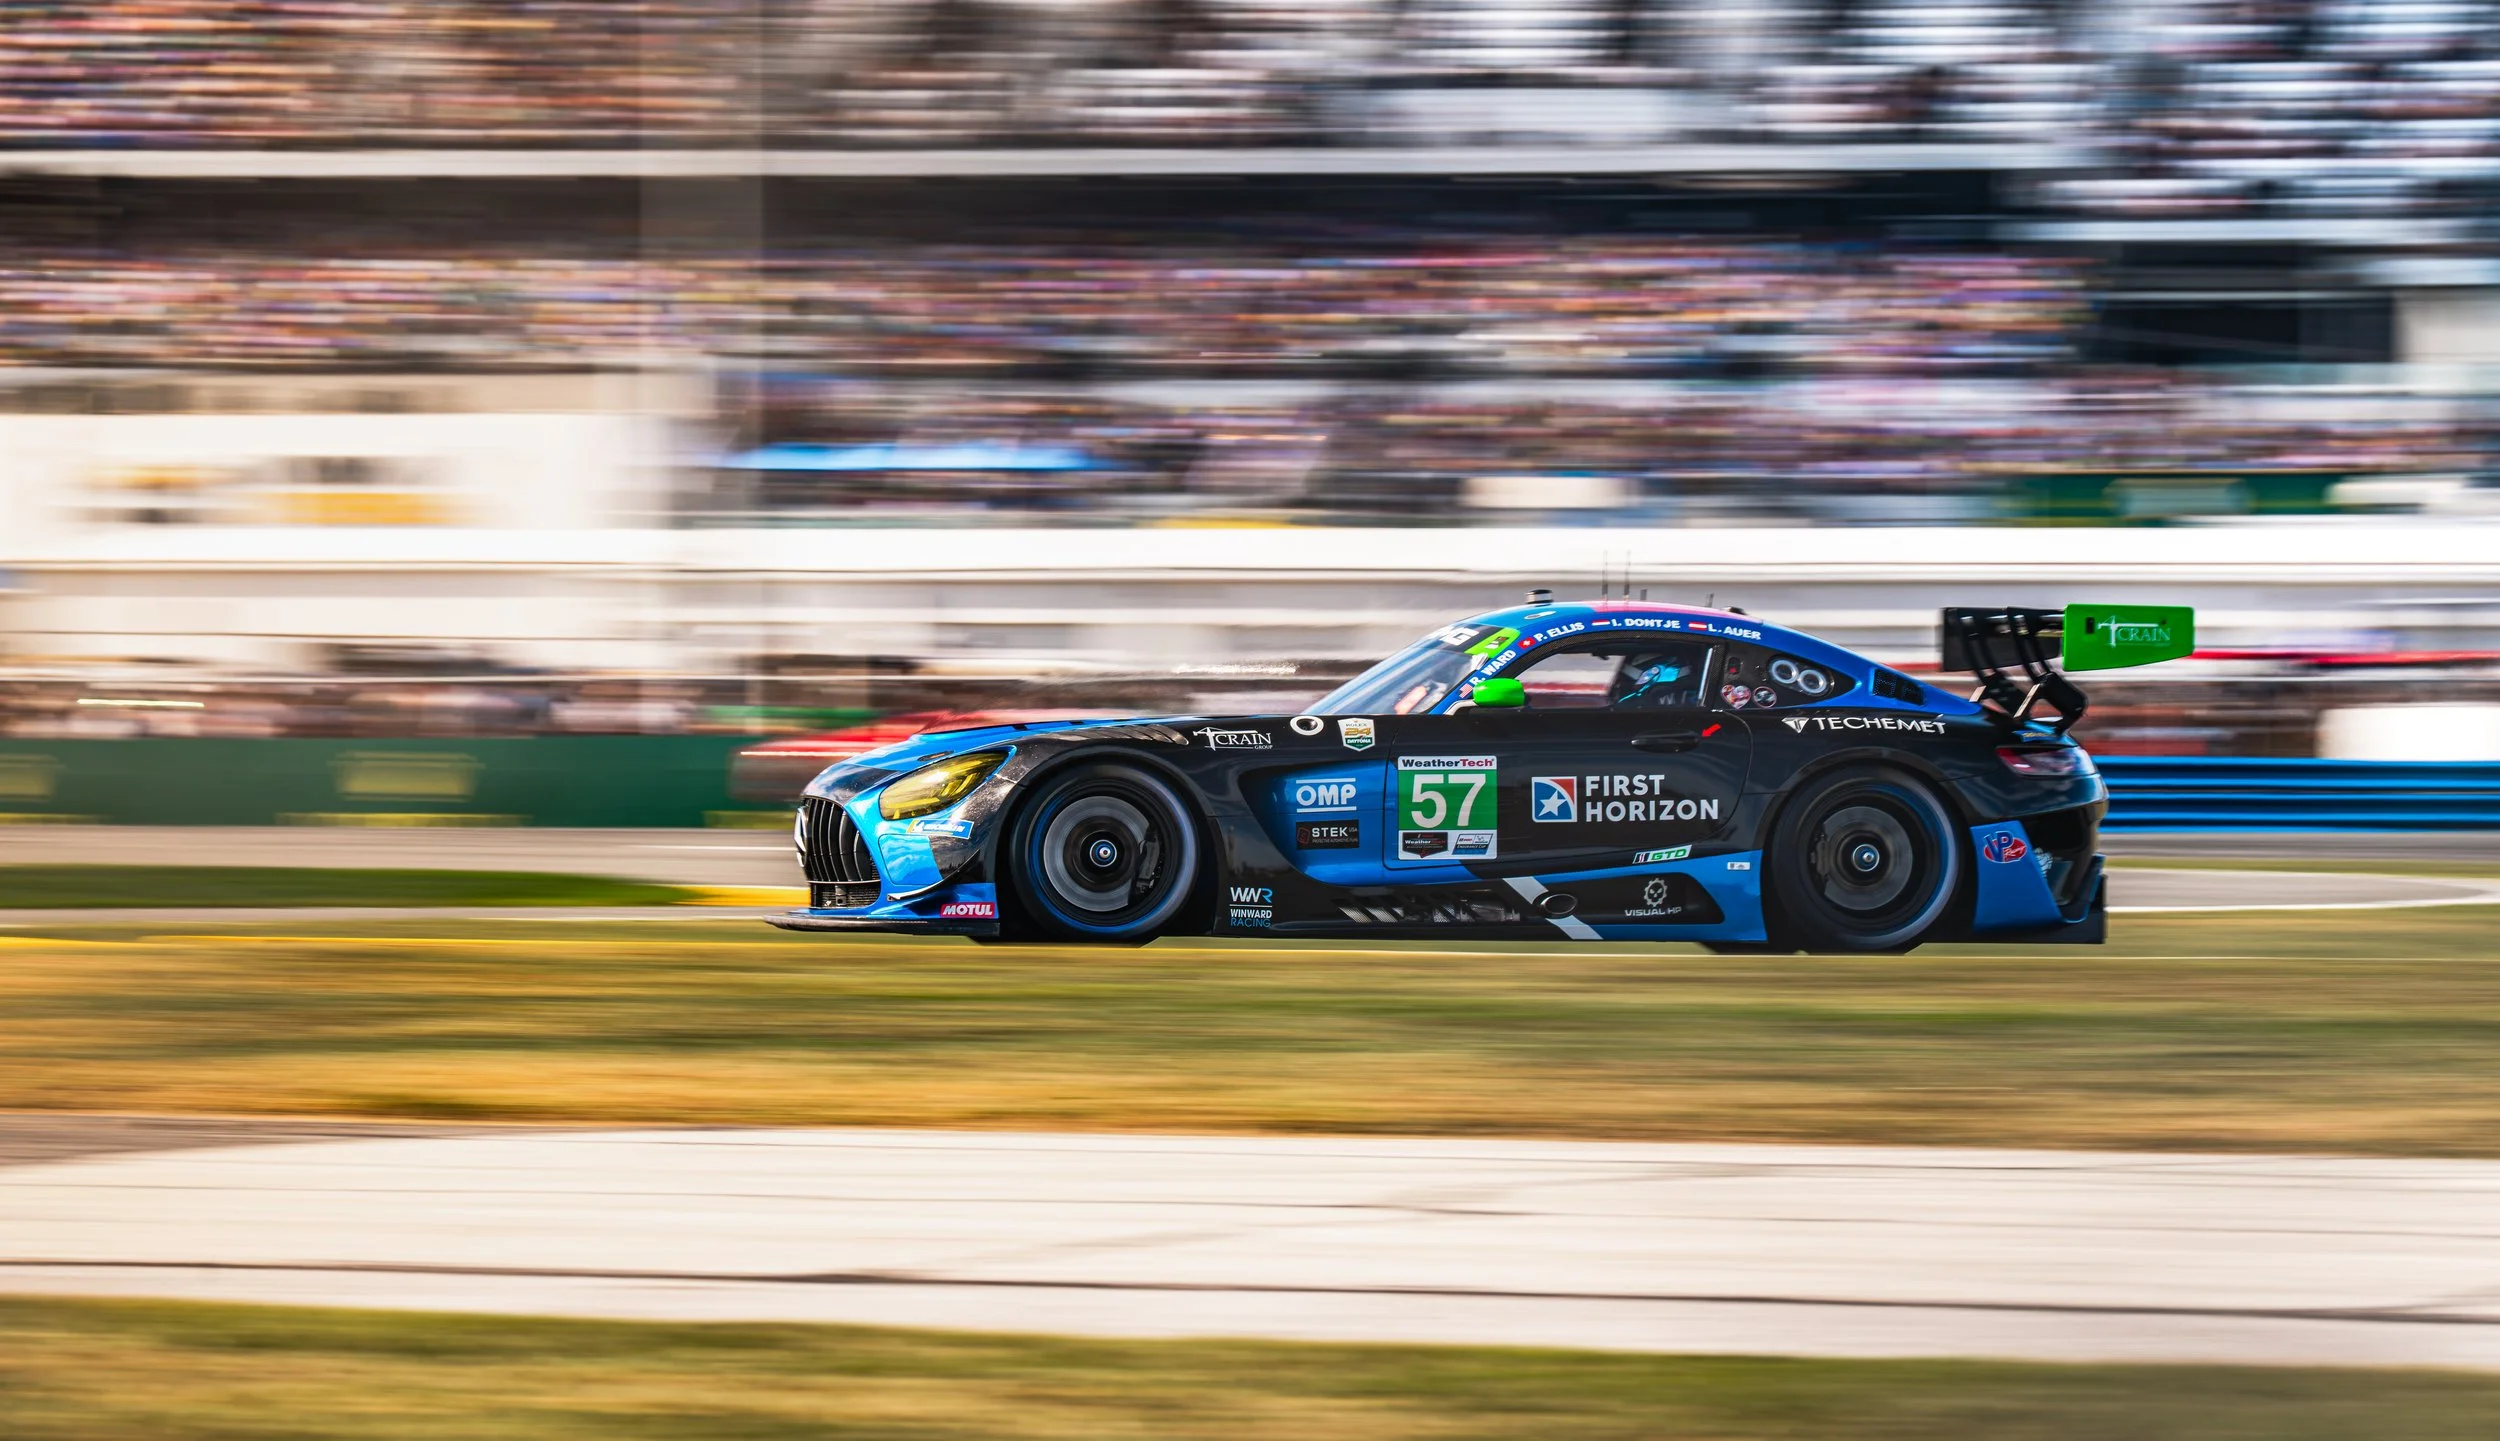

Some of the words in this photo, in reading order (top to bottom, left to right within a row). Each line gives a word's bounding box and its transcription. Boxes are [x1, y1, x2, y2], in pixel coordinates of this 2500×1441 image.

[1610, 618, 1622, 628] I.
[1533, 632, 1548, 643] P.
[1546, 622, 1585, 638] ELLIS
[1708, 623, 1722, 634] L.
[1725, 627, 1762, 640] AUER
[1469, 676, 1486, 687] R.
[1480, 649, 1517, 676] WARD
[1344, 727, 1371, 736] 24
[1812, 715, 1947, 735] TECHEMET
[1402, 758, 1494, 768] WeatherTech
[1585, 774, 1665, 797] FIRST
[1296, 784, 1357, 806] OMP
[1411, 773, 1487, 829] 57
[1585, 799, 1719, 823] HORIZON
[1311, 826, 1349, 838] STEK
[1984, 831, 2014, 862] VP
[1651, 849, 1687, 860] GTD
[942, 903, 993, 916] MOTUL
[1230, 908, 1272, 919] WINWARD
[1625, 908, 1665, 917] VISUAL
[1667, 906, 1682, 914] HP
[1230, 917, 1271, 928] RACING
